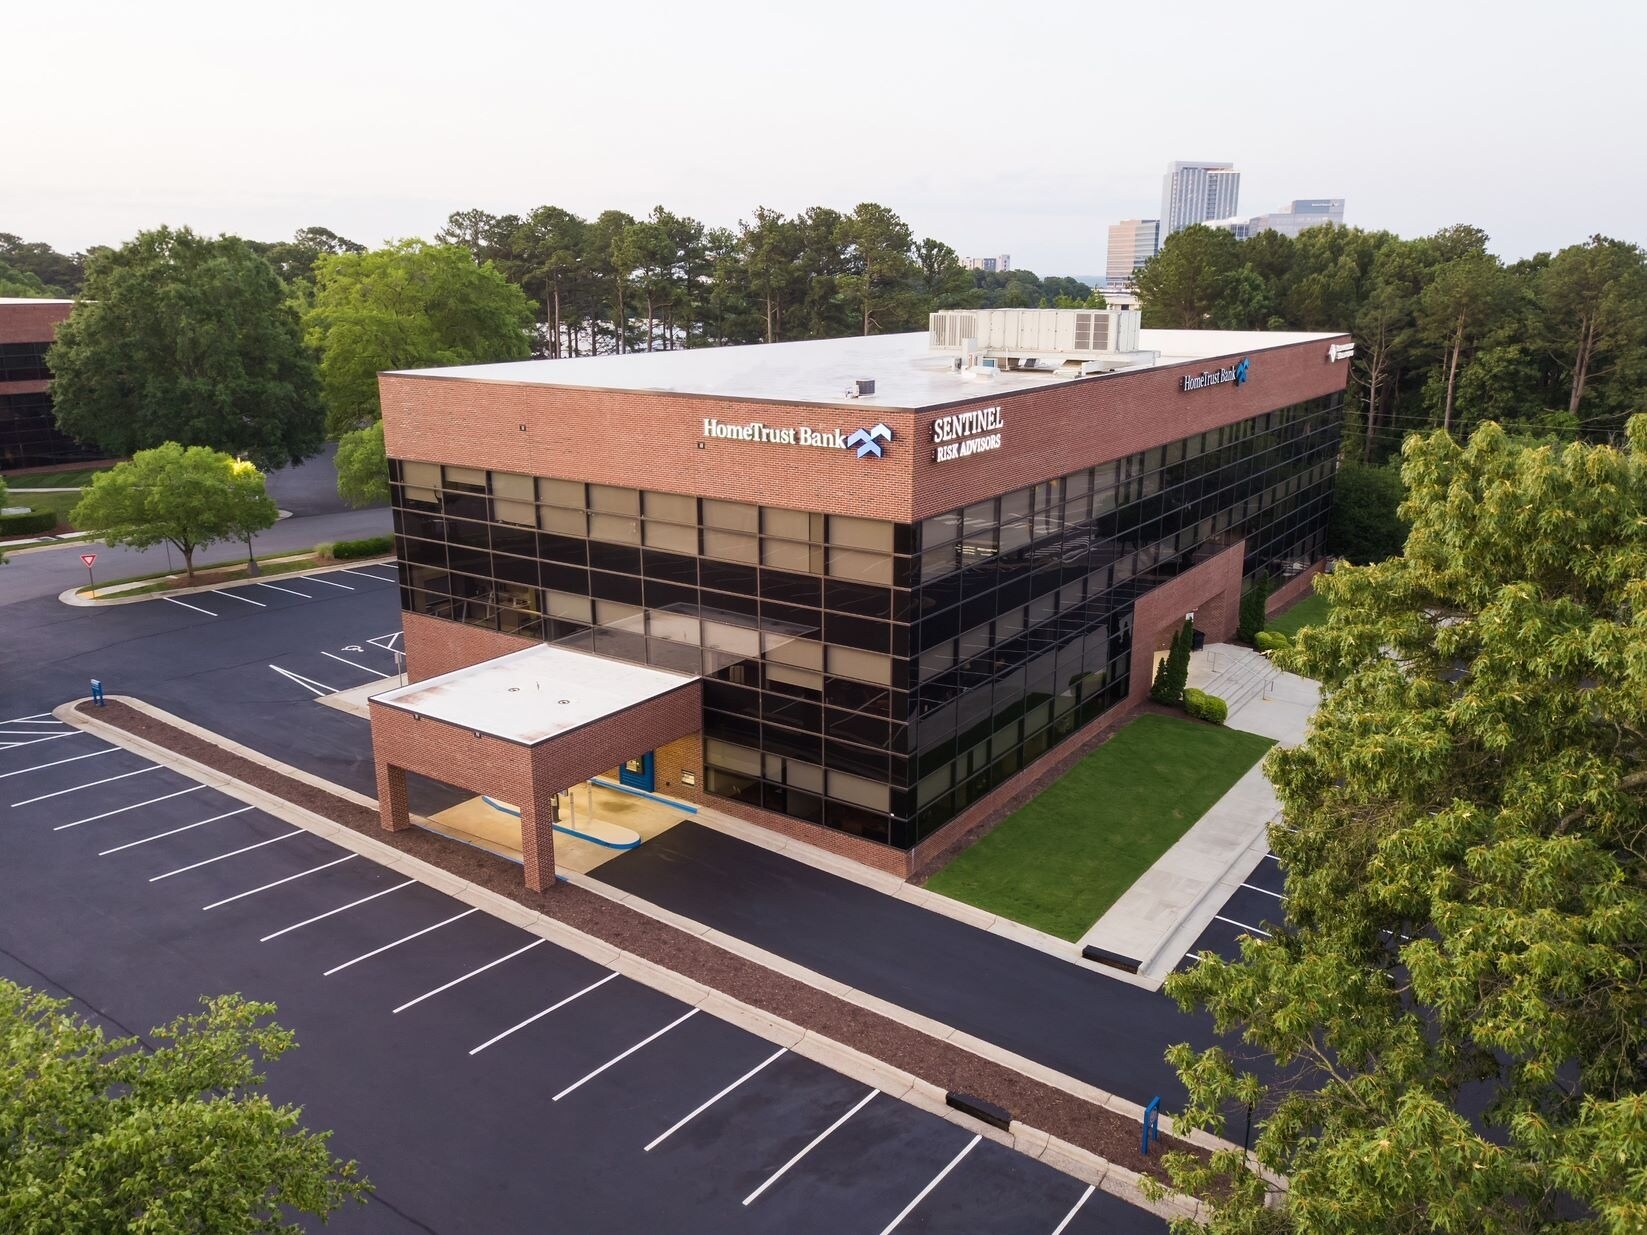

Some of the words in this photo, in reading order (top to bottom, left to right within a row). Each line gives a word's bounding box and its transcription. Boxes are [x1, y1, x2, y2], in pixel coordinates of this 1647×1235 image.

[1184, 371, 1220, 391] HomeTrust
[1221, 366, 1236, 382] Bank
[703, 418, 796, 444] HomeTrust
[800, 427, 847, 449] Bank
[934, 407, 1004, 443] SENTINEL
[937, 443, 959, 462] RISK
[960, 434, 1002, 456] ADVISORS
